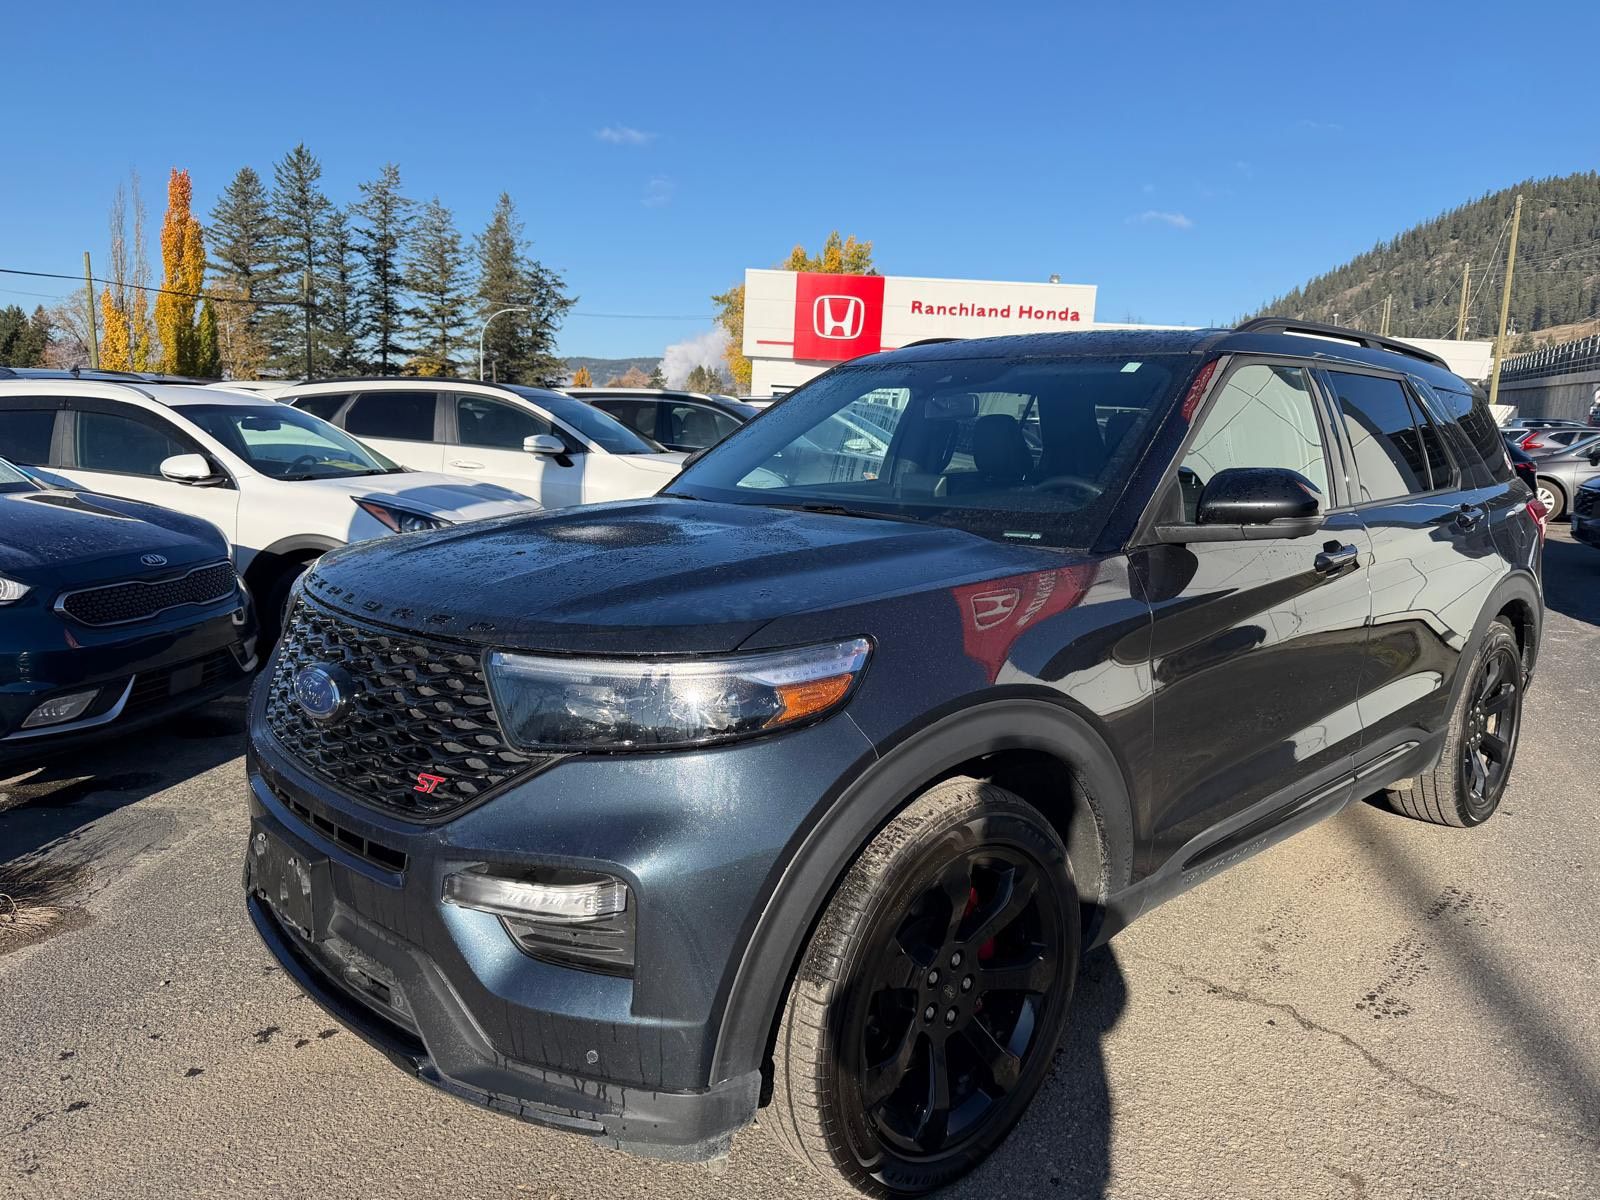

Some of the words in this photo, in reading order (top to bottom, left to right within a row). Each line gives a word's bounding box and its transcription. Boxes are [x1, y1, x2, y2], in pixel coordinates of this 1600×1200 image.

[911, 300, 1011, 319] Ranchland
[1018, 304, 1081, 322] Honda
[413, 772, 448, 793] ST
